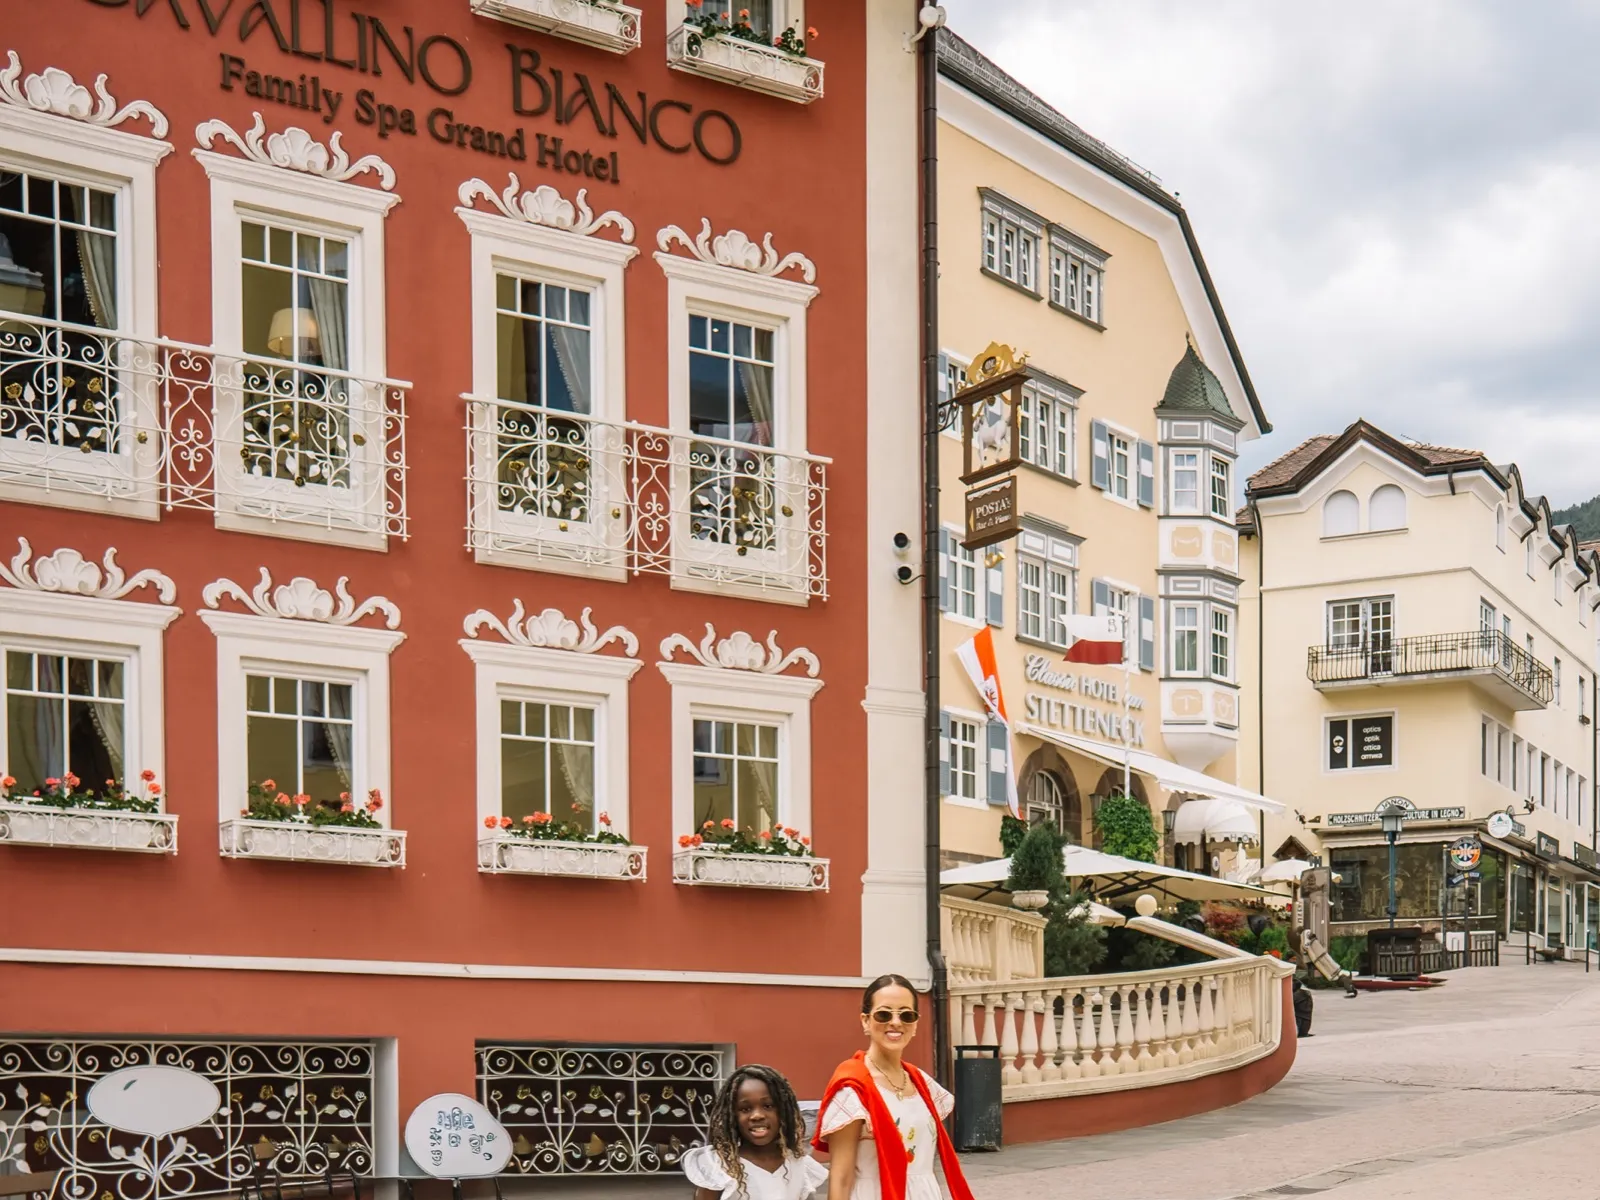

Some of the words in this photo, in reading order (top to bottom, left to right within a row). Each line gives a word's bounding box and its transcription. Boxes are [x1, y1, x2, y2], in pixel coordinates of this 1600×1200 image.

[86, 0, 473, 97] VALLINO
[504, 43, 742, 165] BIANCO
[219, 52, 343, 124] Family
[355, 88, 417, 139] Spa
[427, 107, 527, 162] Grand
[535, 132, 620, 184] Hotel
[1079, 676, 1119, 704] HOTEL
[1025, 693, 1145, 746] STETTENECK
[1362, 725, 1381, 734] optics
[1363, 735, 1380, 743] optik
[1431, 809, 1439, 818] IN
[1440, 808, 1460, 818] LEGNO
